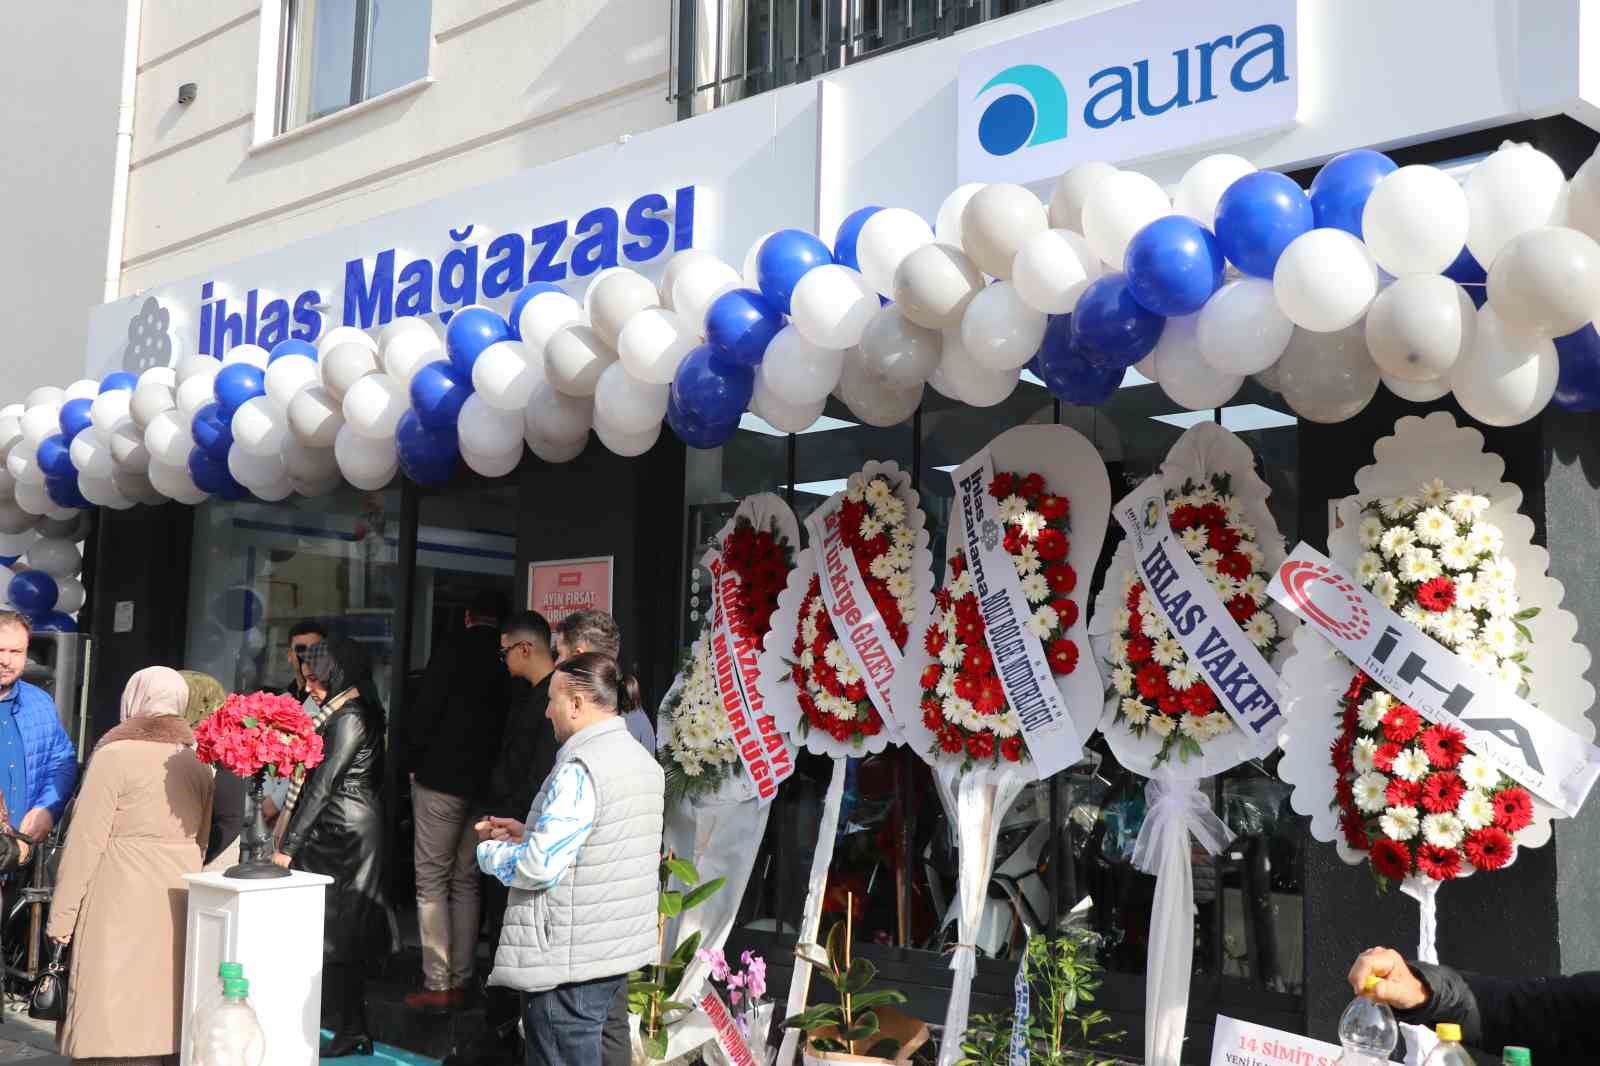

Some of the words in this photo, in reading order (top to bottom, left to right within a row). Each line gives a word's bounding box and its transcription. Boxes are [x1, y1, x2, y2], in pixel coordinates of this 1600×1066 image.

[1083, 24, 1289, 129] aura
[198, 281, 322, 362] İhlas
[343, 185, 696, 329] Mağazası
[960, 476, 988, 597] Pazarlama
[981, 588, 1014, 629] BOLU
[1141, 535, 1207, 636] İHLAS
[1195, 626, 1282, 733] VAKFI
[1371, 625, 1545, 776] İHA
[1238, 1036, 1257, 1053] 14
[1261, 1039, 1314, 1066] SİMİT
